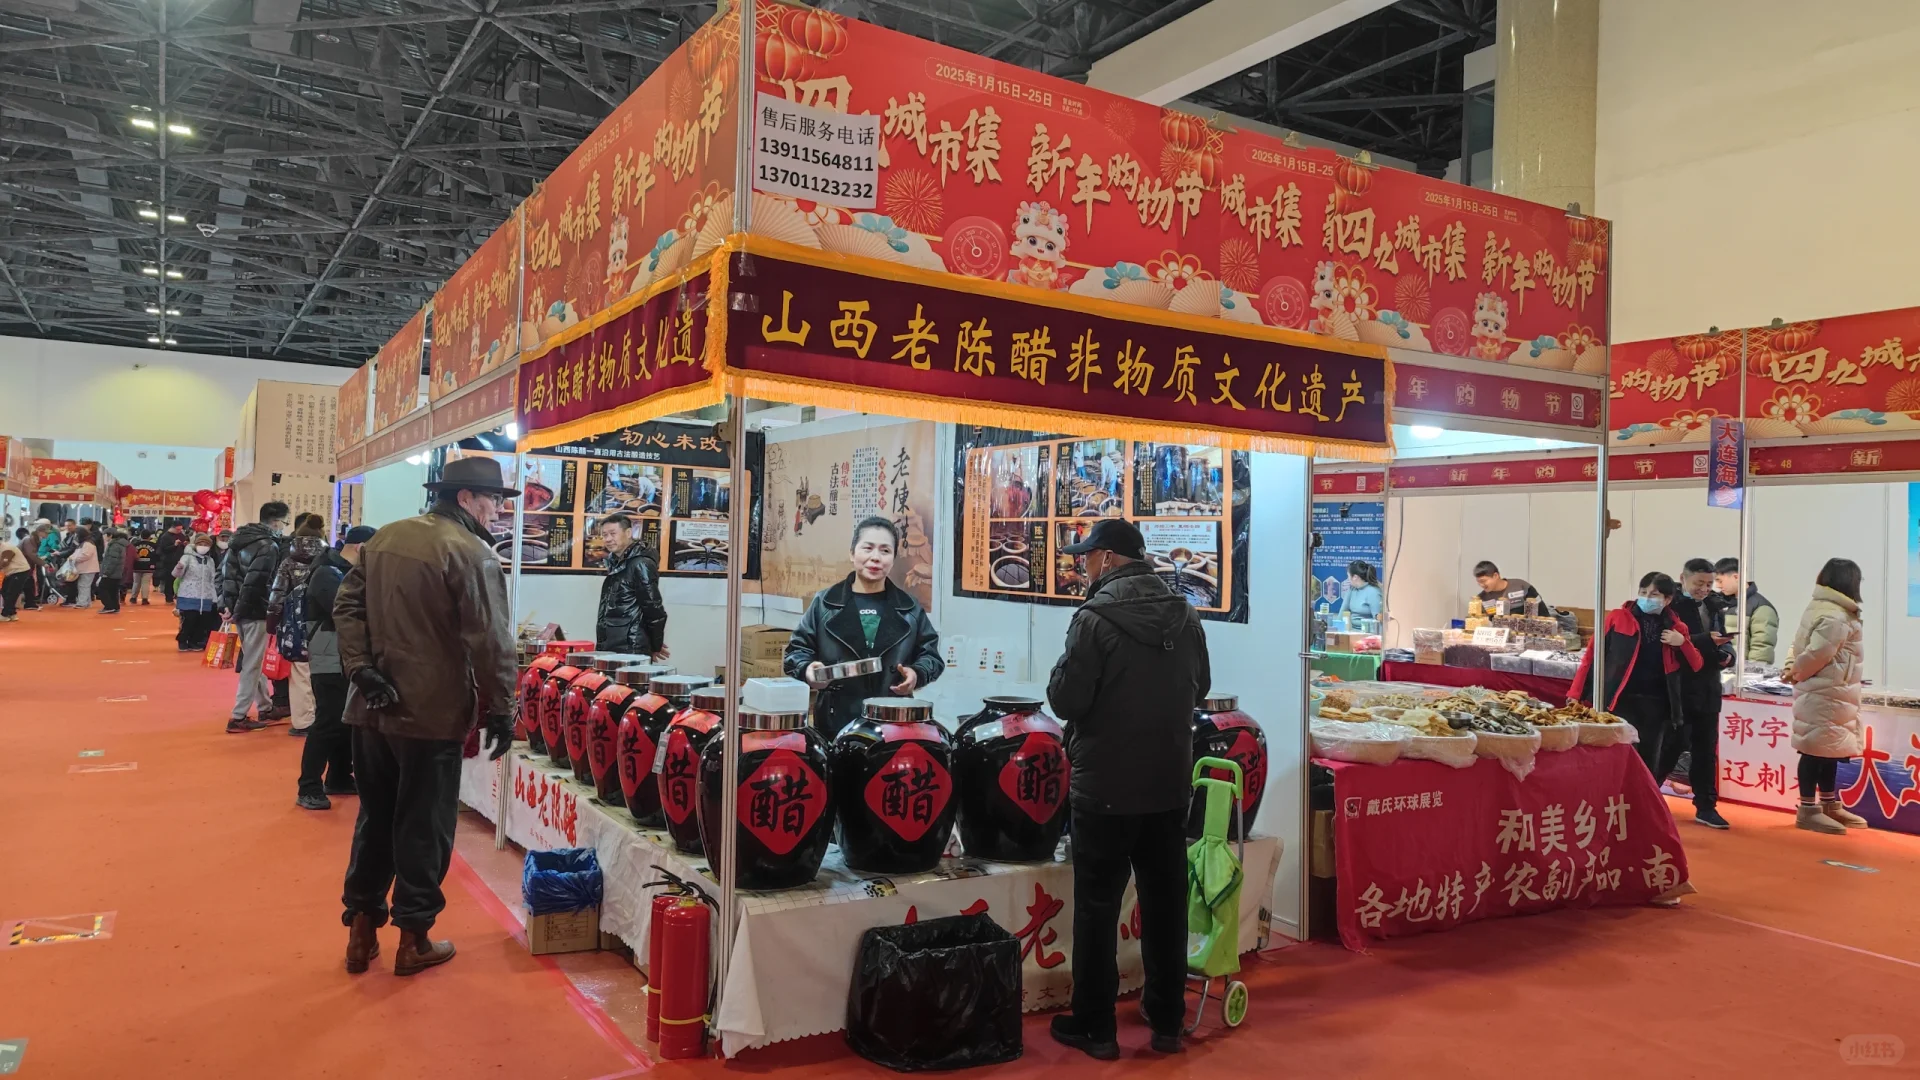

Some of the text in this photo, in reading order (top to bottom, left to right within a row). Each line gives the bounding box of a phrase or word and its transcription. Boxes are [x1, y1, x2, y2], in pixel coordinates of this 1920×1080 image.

[761, 106, 875, 146] 售后服务电话
[531, 78, 728, 272] 四九城市集 新年购物节
[760, 137, 874, 172] 13911564811
[1027, 123, 1204, 236] 新年购物节
[760, 165, 873, 198] 13701123232
[1333, 207, 1467, 288] 四九城市集
[1482, 230, 1597, 316] 新年购物节
[761, 290, 1366, 423] 山西老陈醋非物质文化遗产
[620, 429, 722, 453] 初心未改
[1714, 422, 1739, 506] 大连海参
[1780, 459, 1792, 469] 48
[1407, 475, 1416, 484] 49
[1723, 712, 1789, 749] 郭字
[750, 766, 813, 837] 醋
[881, 760, 940, 826] 醋
[1015, 746, 1063, 808] 醋
[1366, 790, 1443, 816] 戴氏环球展览
